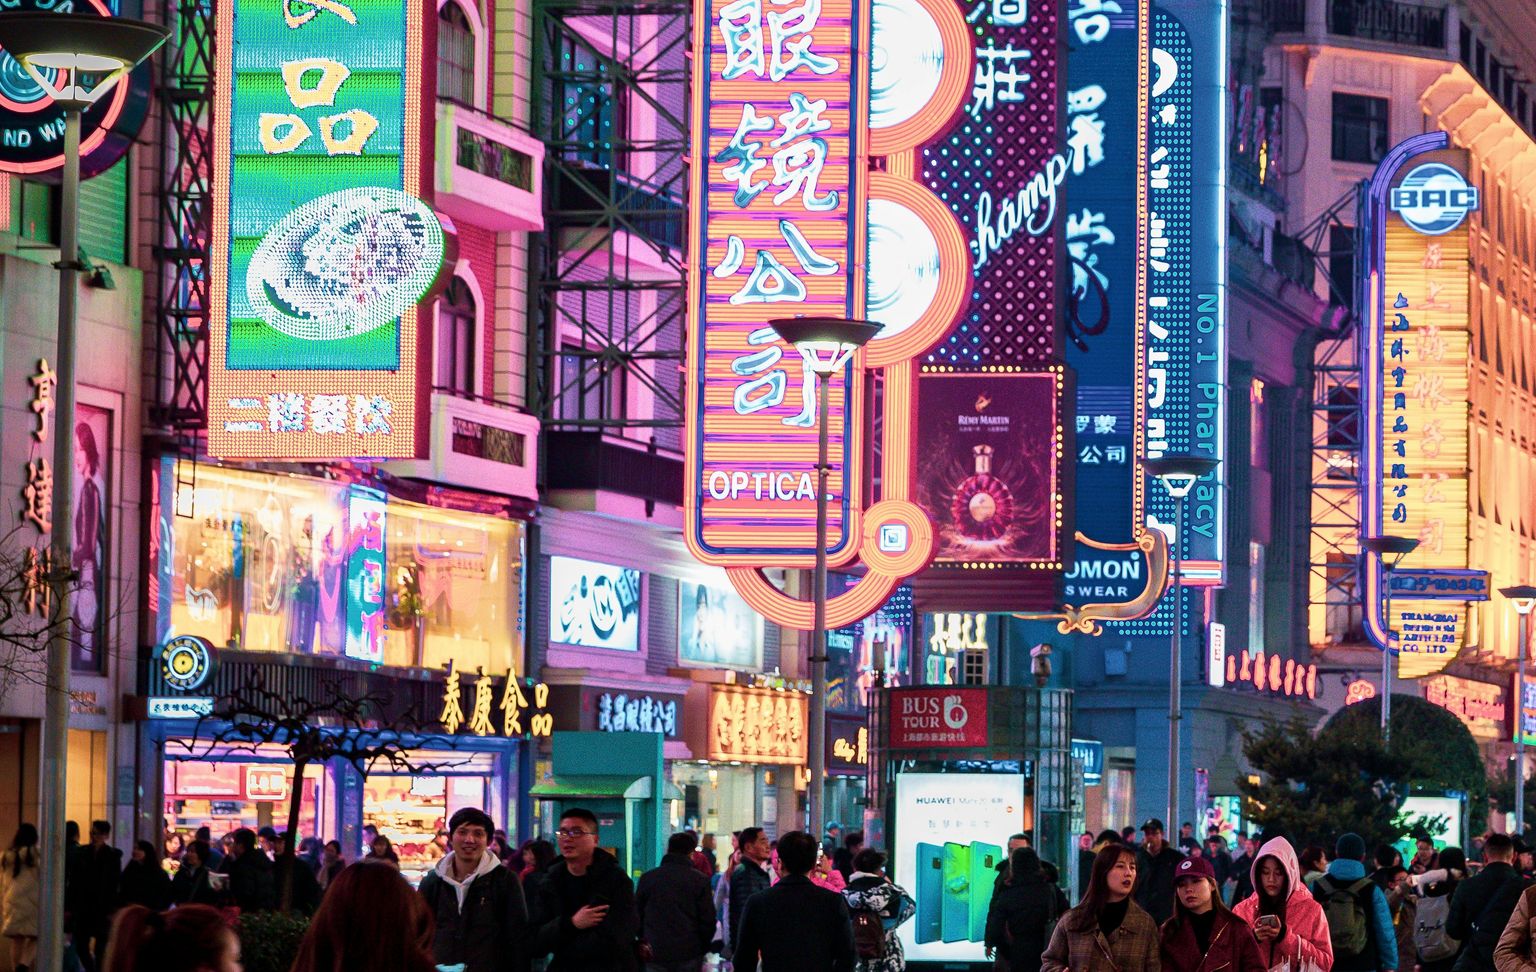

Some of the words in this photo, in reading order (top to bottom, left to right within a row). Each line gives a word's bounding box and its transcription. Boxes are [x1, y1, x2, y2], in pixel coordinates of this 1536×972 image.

[713, 0, 839, 427] 眼镜公司
[972, 150, 1072, 269] hamp
[1393, 190, 1474, 207] BAC
[224, 392, 393, 434] 二楼餐饮
[1080, 445, 1126, 464] 公司
[1192, 383, 1218, 538] Pharacy
[1078, 586, 1128, 597] WEAR
[440, 659, 553, 736] 泰康食品
[902, 697, 939, 714] BUS
[902, 715, 939, 729] TOUR
